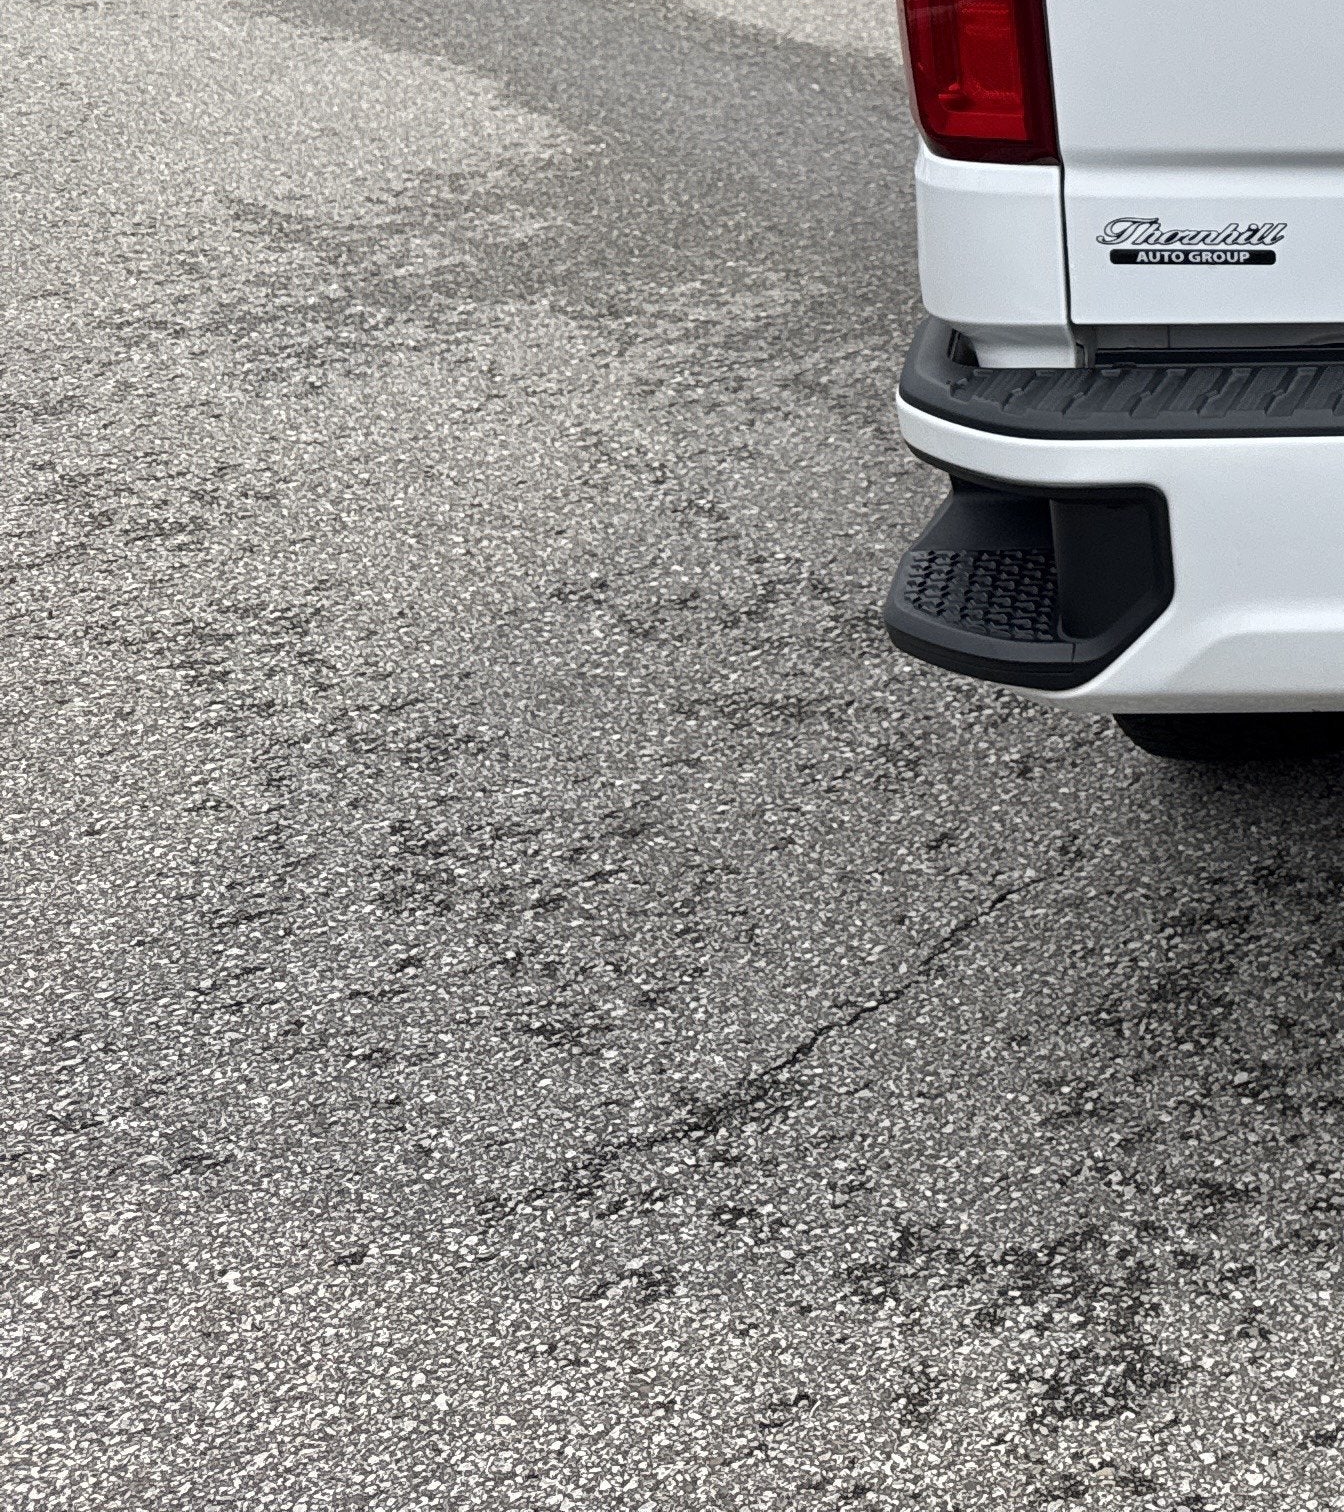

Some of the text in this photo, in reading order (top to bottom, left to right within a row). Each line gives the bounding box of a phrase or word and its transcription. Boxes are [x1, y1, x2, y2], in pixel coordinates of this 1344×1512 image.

[1096, 217, 1287, 245] Thornhill
[1136, 250, 1250, 263] AUTO GROUP
